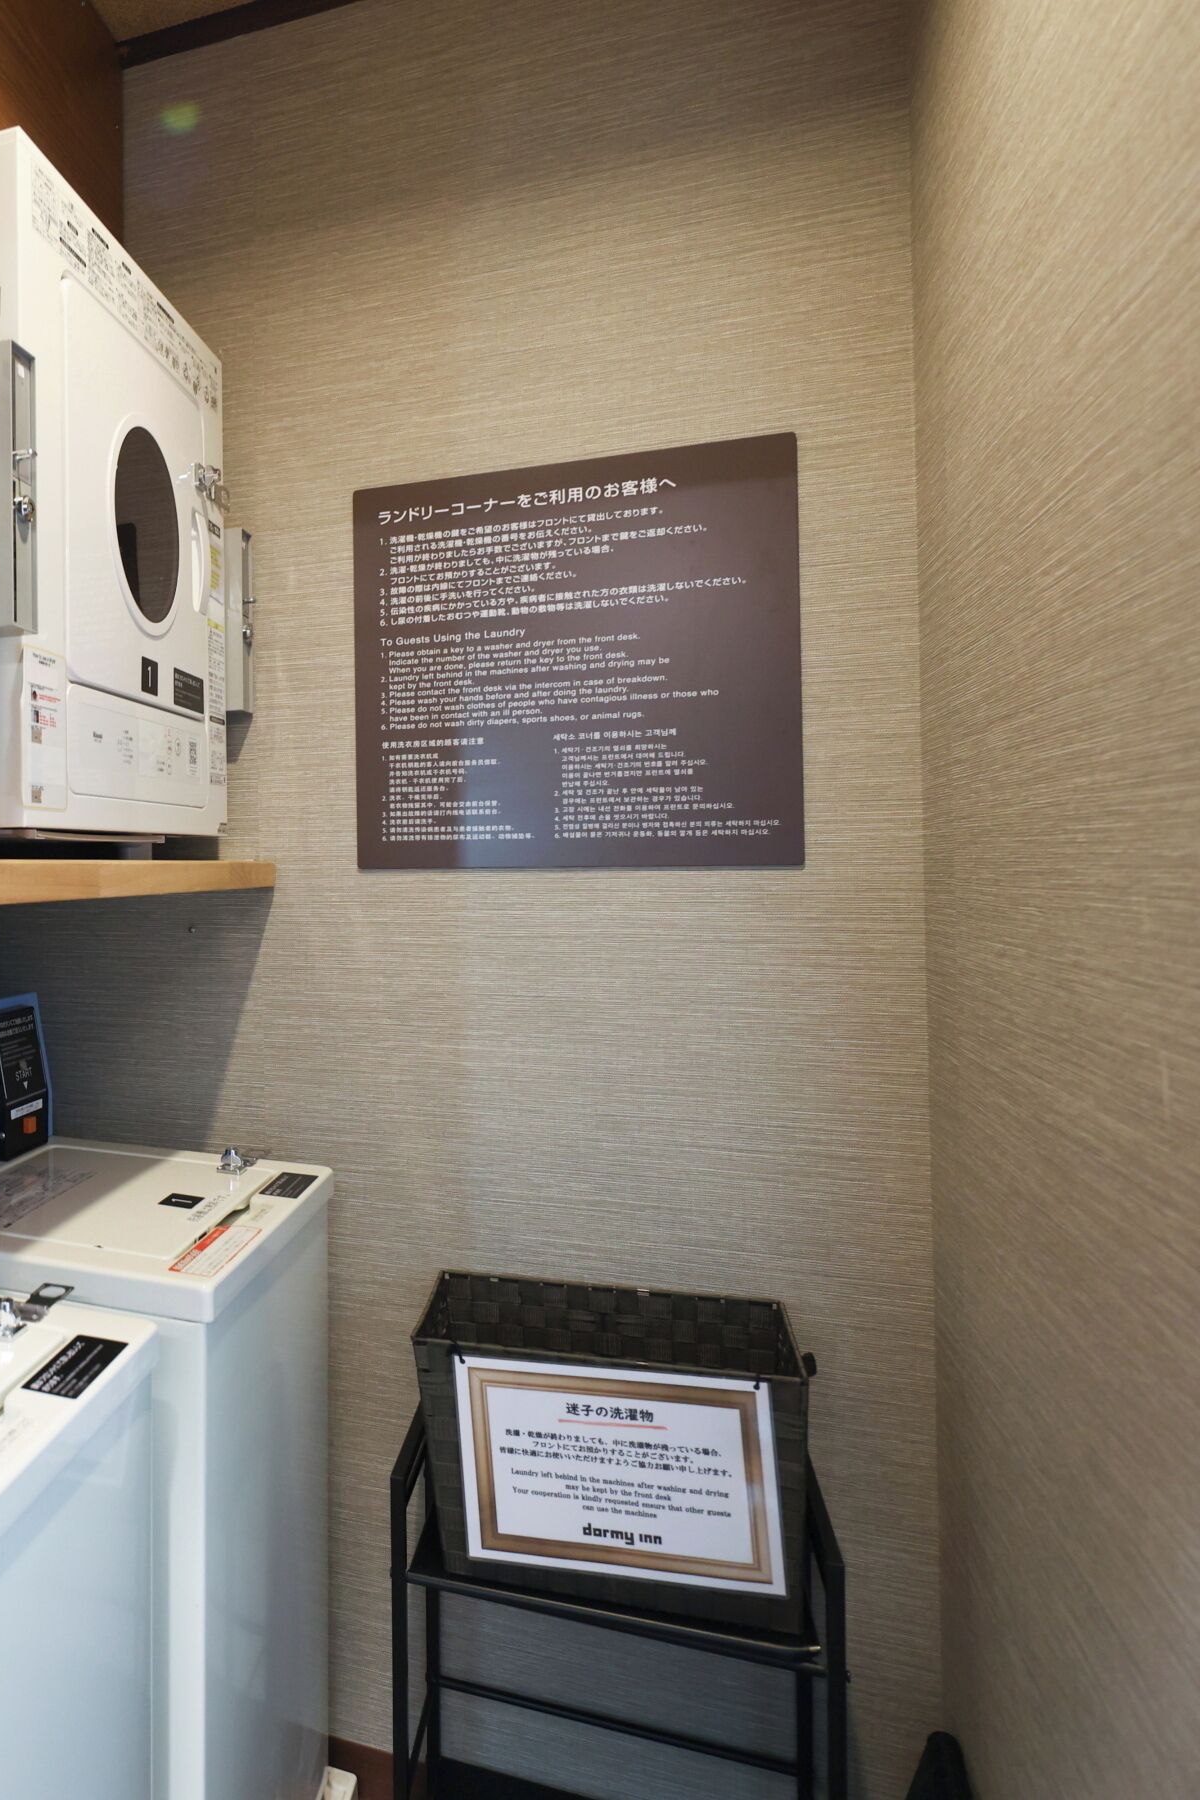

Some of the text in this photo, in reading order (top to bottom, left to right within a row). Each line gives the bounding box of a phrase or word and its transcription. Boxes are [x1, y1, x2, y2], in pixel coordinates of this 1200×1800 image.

[377, 474, 676, 526] ランドリーコーナーをご利用のお客様へ
[379, 537, 387, 545] 1.
[379, 567, 387, 576] 2.
[379, 587, 388, 596] 3.
[379, 598, 387, 607] 4.
[379, 607, 388, 617] 5.
[379, 617, 388, 627] 6.
[379, 626, 525, 647] To Guests Using the Laundry
[380, 651, 386, 659] 1.
[388, 648, 415, 658] Please
[416, 647, 441, 656] obtain
[449, 645, 464, 654] key
[483, 641, 513, 651] washer
[515, 640, 531, 648] and
[532, 638, 555, 648] dryer
[556, 636, 576, 645] from
[578, 635, 592, 644] the
[594, 633, 614, 642] front
[616, 631, 640, 641] desk.
[388, 644, 601, 666] Indicate the number of the washer and dryer you use.
[388, 665, 411, 674] When
[412, 665, 427, 673] you
[443, 662, 466, 671] done,
[467, 659, 495, 669] please
[497, 658, 521, 667] return
[523, 656, 537, 665] the
[539, 655, 554, 664] key
[556, 655, 565, 663] to
[566, 653, 581, 662] the
[582, 651, 603, 660] front
[604, 650, 628, 659] desk.
[147, 665, 152, 688] 1
[380, 656, 670, 683] 2. Laundry left behind in the machines after washing and drying may be
[380, 691, 387, 699] 3.
[388, 688, 415, 698] Please
[416, 687, 446, 697] contact
[447, 686, 460, 695] the
[462, 685, 481, 694] front
[482, 683, 502, 692] desk
[504, 683, 517, 691] via
[518, 682, 532, 690] the
[534, 680, 570, 689] intercom
[583, 678, 604, 686] case
[605, 676, 615, 685] of
[616, 673, 667, 684] breakdown.
[388, 677, 474, 691] kept by the front desk.
[15, 1066, 33, 1082] START
[565, 1401, 654, 1423] 迷子の洗濯物
[638, 1533, 662, 1545] inn
